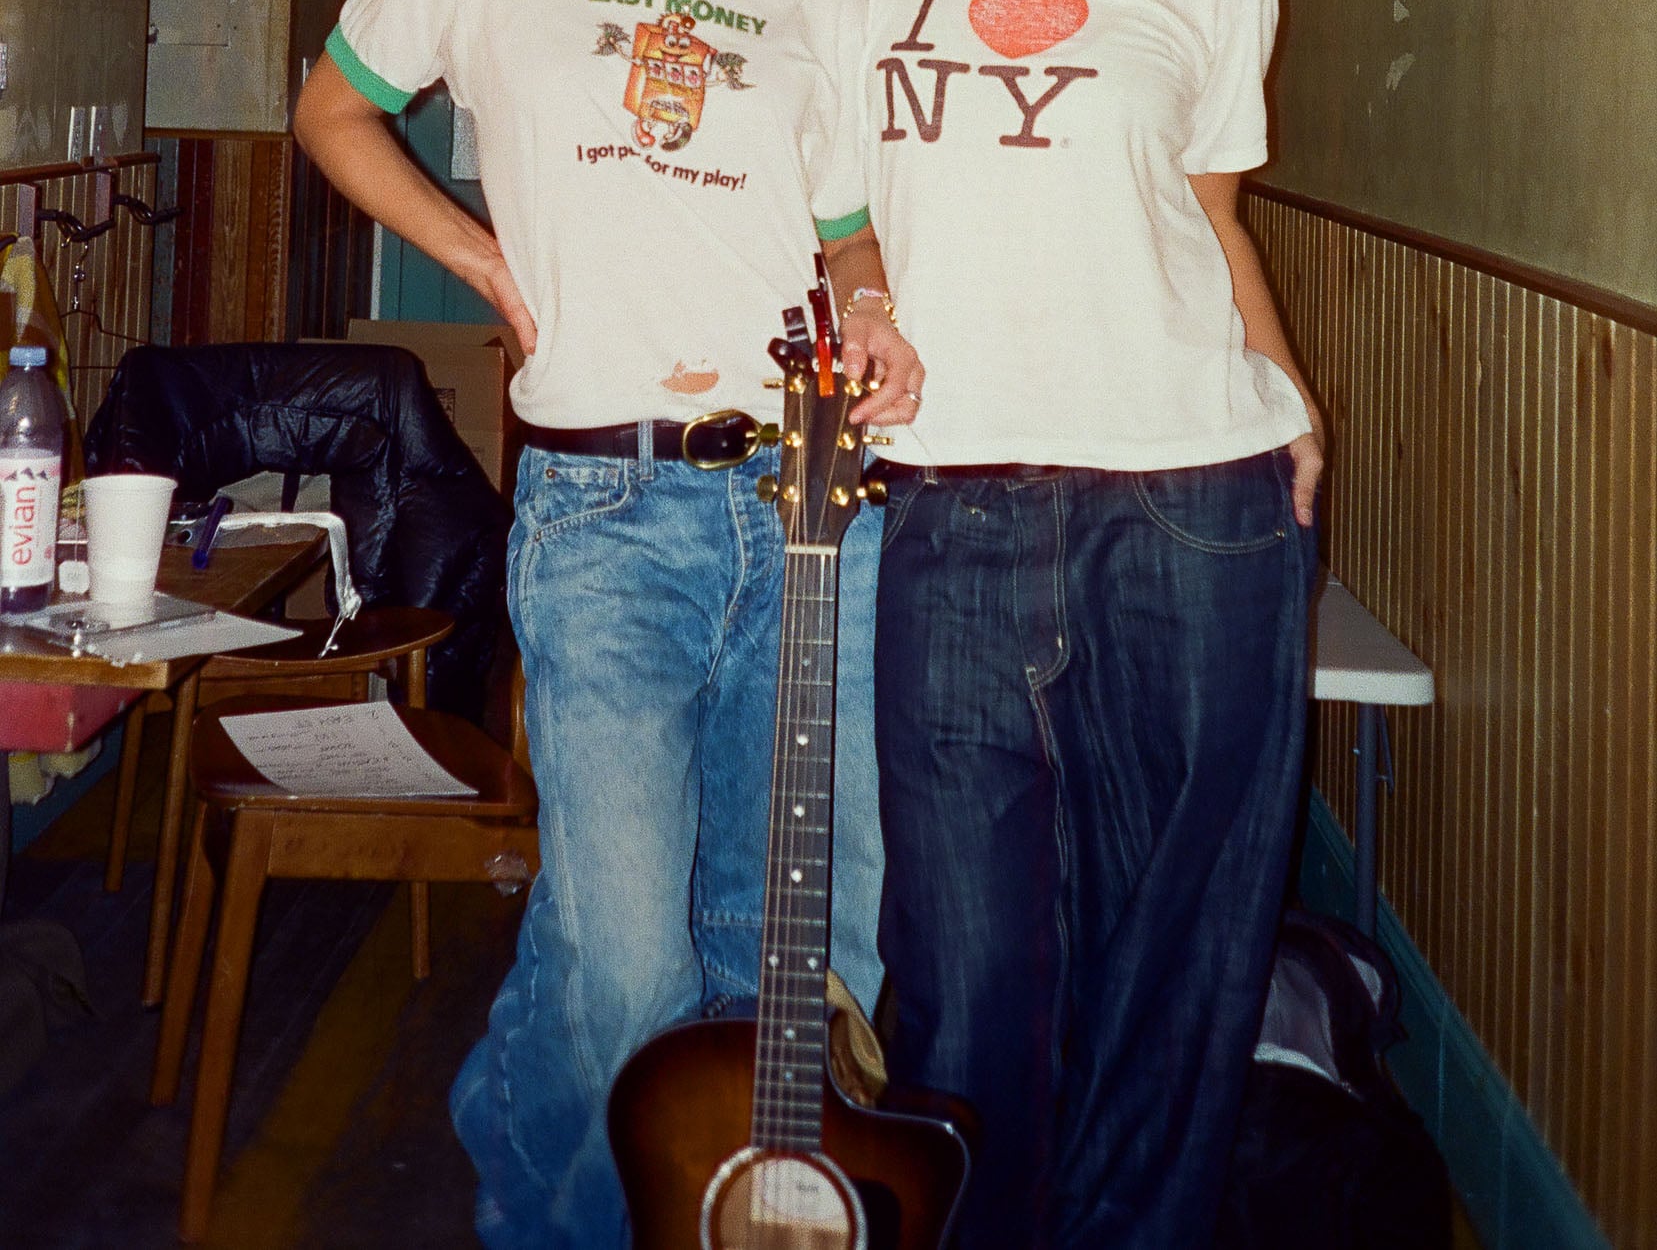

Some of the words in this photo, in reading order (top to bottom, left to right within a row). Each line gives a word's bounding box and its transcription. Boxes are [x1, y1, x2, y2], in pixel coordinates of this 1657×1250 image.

[876, 57, 1099, 148] NY
[576, 144, 583, 162] I
[587, 145, 614, 164] got
[672, 166, 700, 184] my
[702, 170, 748, 191] play!
[12, 486, 36, 565] evian
